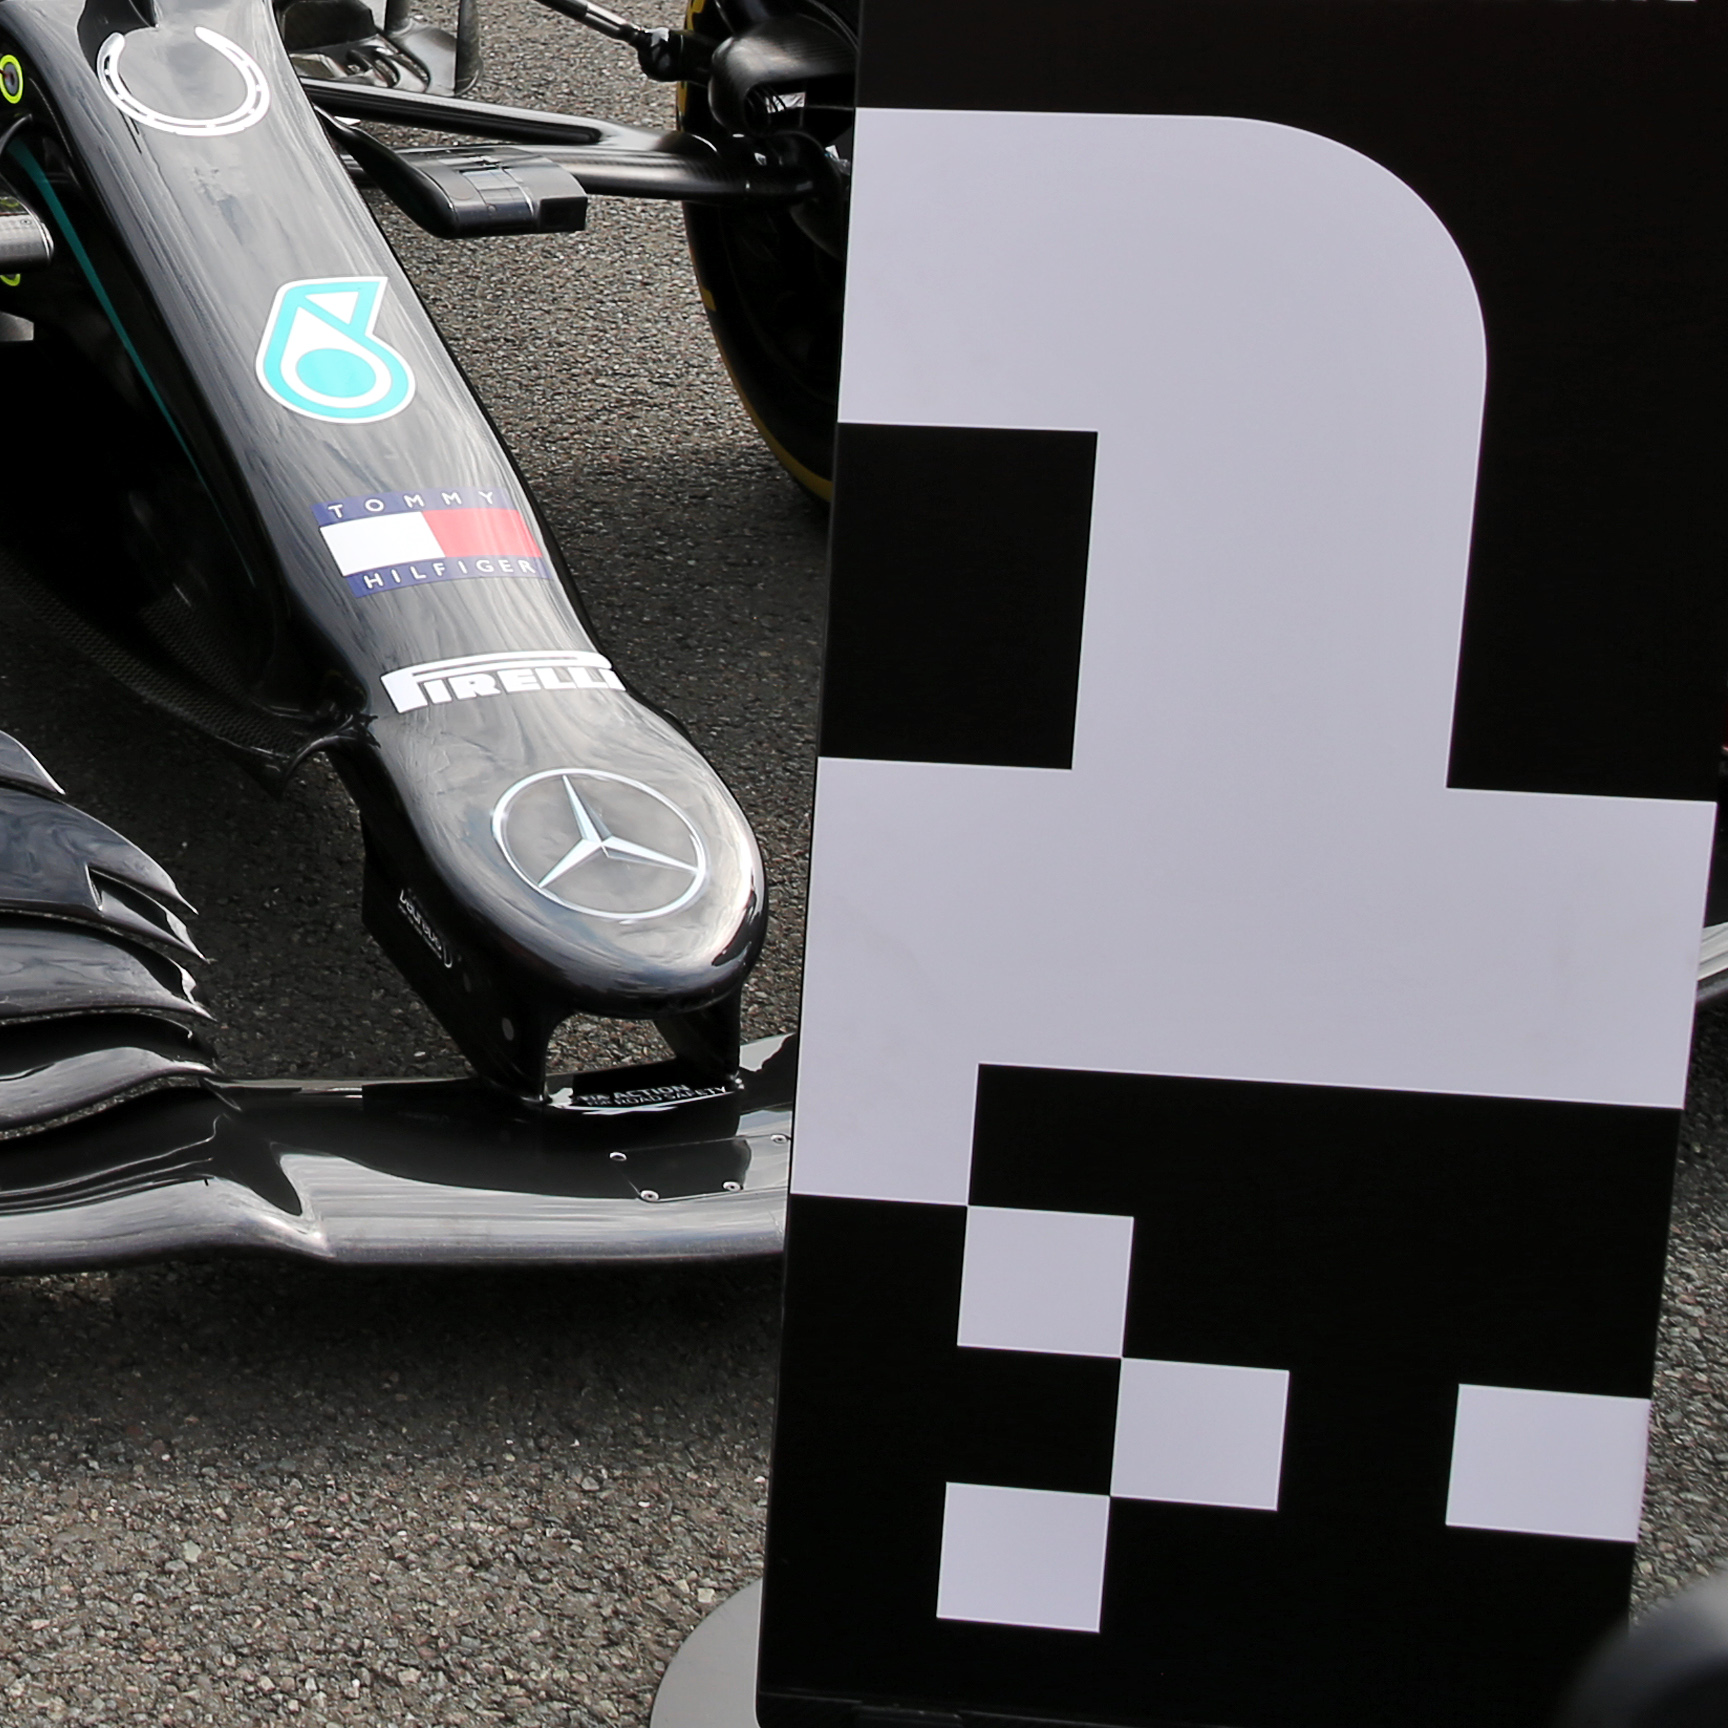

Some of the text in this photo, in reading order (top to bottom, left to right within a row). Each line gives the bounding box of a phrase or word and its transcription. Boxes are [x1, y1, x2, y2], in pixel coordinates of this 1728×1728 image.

[327, 490, 496, 520] TOMMY
[362, 558, 538, 590] HILFIGER
[380, 649, 627, 714] PIRELLI
